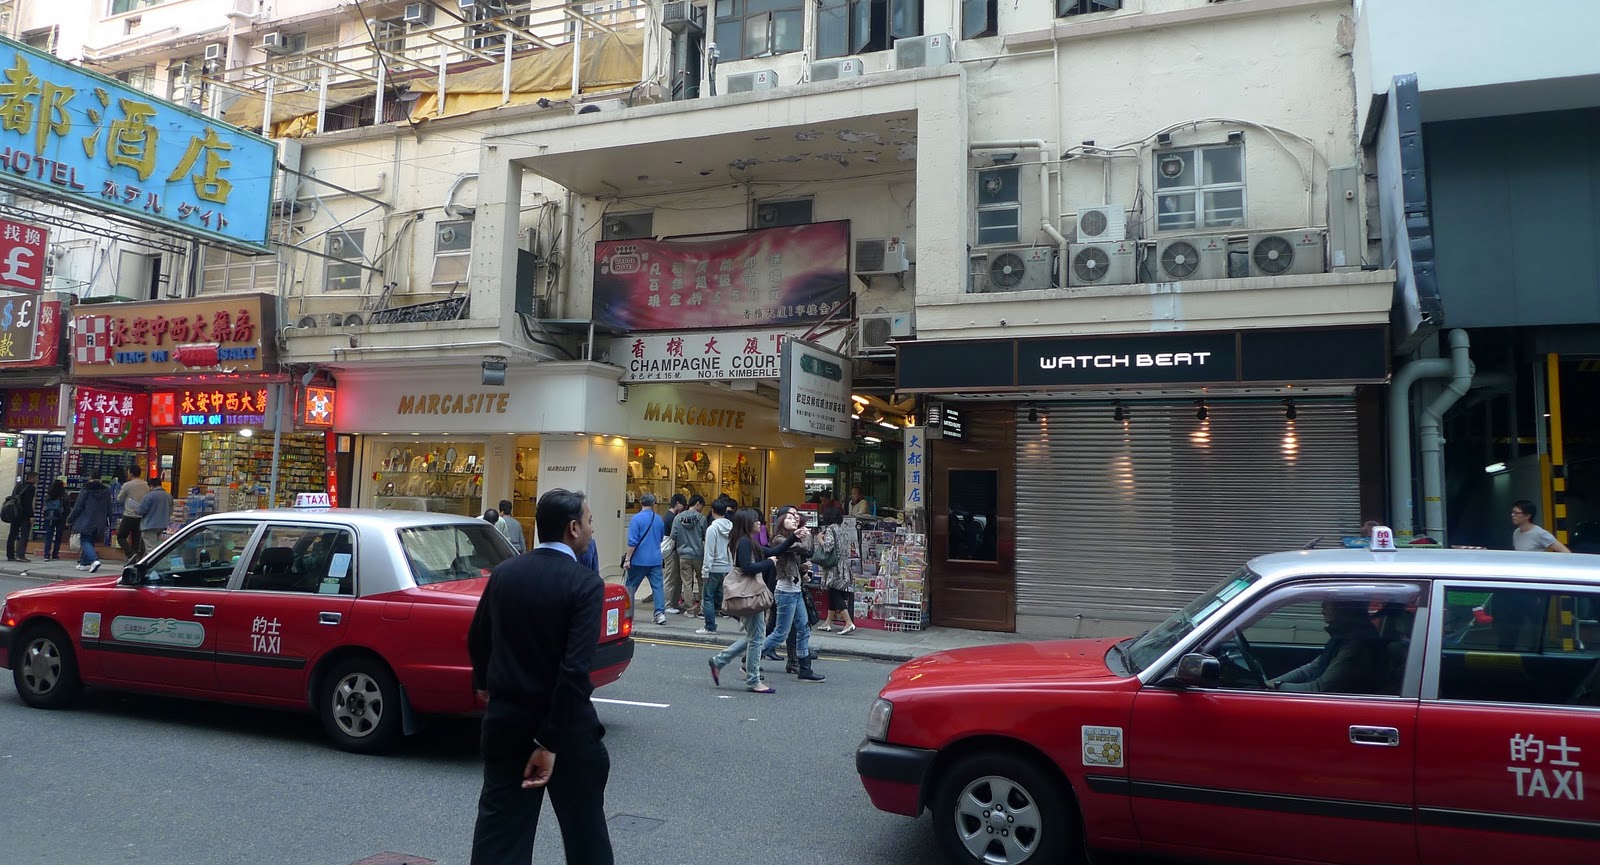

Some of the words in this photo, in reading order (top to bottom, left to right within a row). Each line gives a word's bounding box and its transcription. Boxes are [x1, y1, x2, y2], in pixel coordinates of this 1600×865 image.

[0, 53, 233, 204] 都酒店
[101, 179, 163, 213] ホテル
[4, 224, 40, 246] 找換
[113, 309, 256, 347] 永安中西大藥房
[150, 350, 168, 363] ON
[631, 336, 762, 359] 香檳大廈
[630, 356, 720, 373] CHAMPAGNE
[1040, 354, 1129, 369] WATCH
[1136, 352, 1211, 367] BEAT
[697, 369, 724, 378] NO.16
[729, 368, 781, 378] KIMBERLE
[80, 391, 134, 416] 永安大藥
[398, 392, 510, 415] MARCASITE
[181, 415, 205, 425] WING
[209, 414, 222, 425] ON
[644, 402, 747, 430] MARCASITE
[907, 434, 922, 502] 大都酒店
[306, 495, 328, 505] TAXI
[1377, 531, 1390, 548] 的士
[252, 615, 282, 635] 的士
[250, 634, 281, 654] TAXI
[1510, 733, 1582, 767] 的士
[1507, 766, 1584, 800] TAXI
